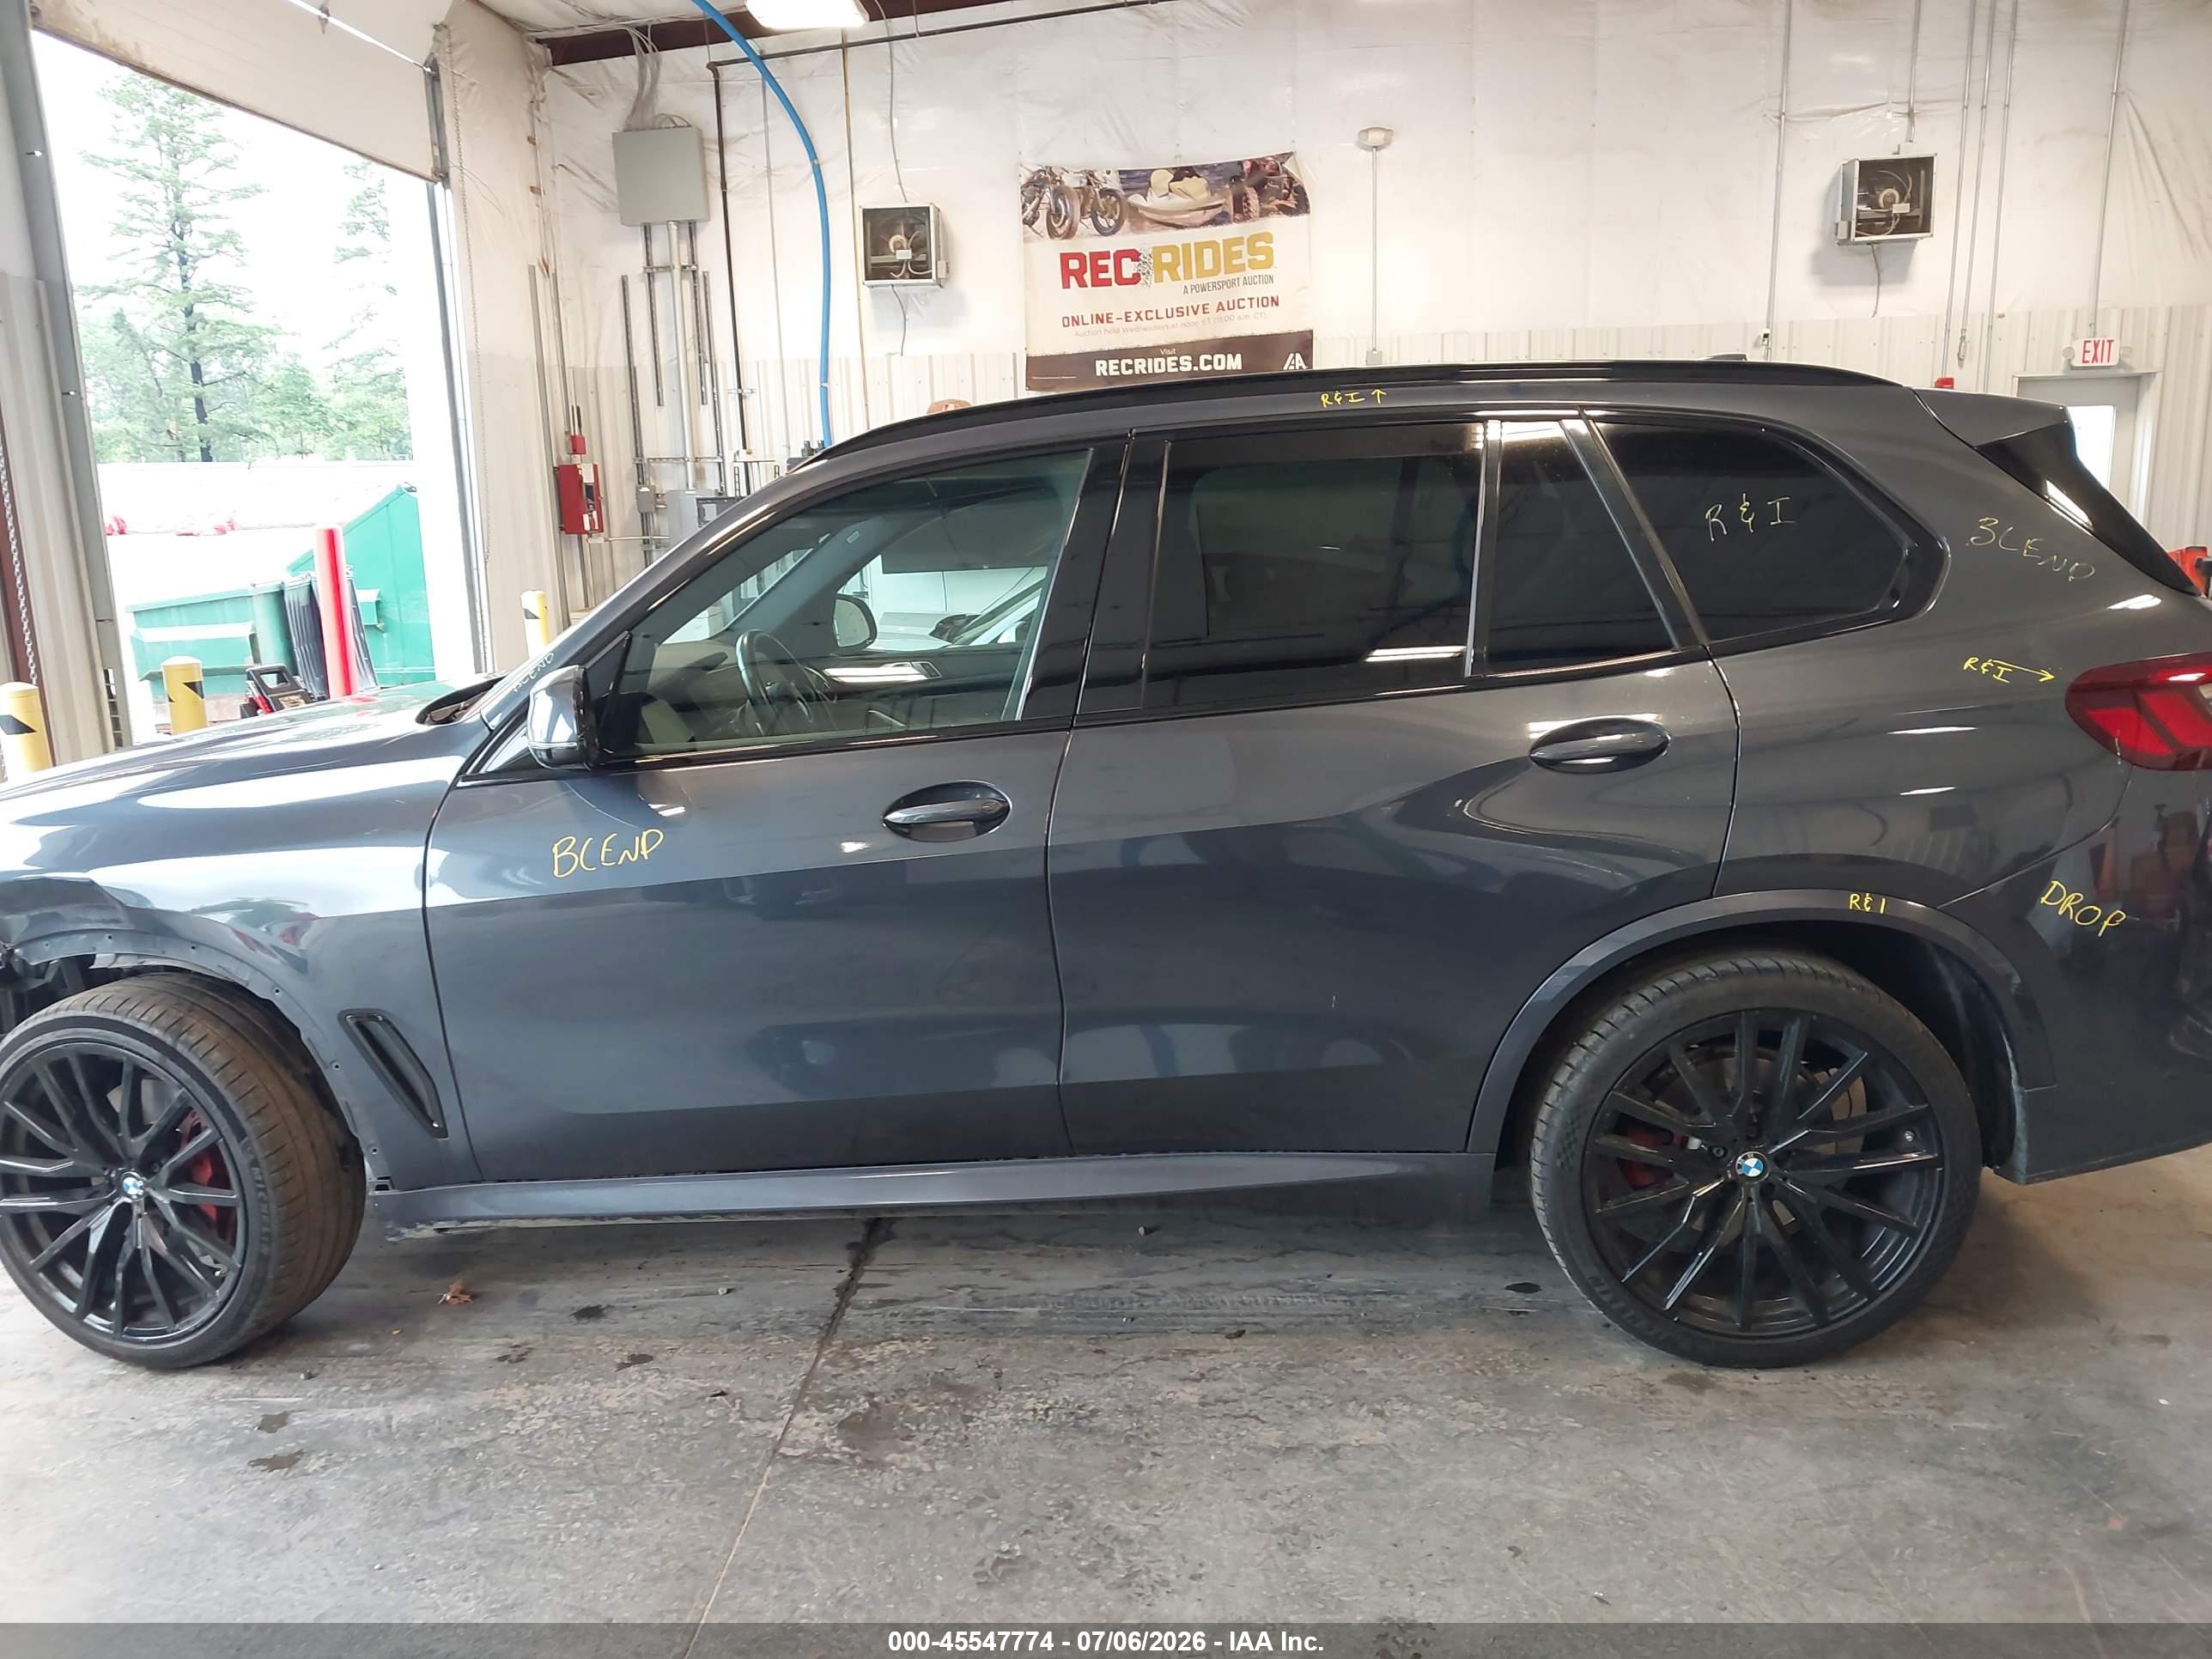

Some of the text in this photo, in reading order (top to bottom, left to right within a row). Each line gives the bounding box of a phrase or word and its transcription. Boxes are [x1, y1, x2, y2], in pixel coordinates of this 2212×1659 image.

[1060, 232, 1274, 289] REC RIDES
[1183, 275, 1274, 295] A POWERSPORT AUCTION
[1062, 295, 1280, 328] ONLINE-EXCLUSIVE AUCTION
[1095, 353, 1243, 377] RECRIDES.COM
[2081, 339, 2115, 364] EXIT
[1705, 503, 1728, 542] R
[2039, 880, 2127, 938] DROP
